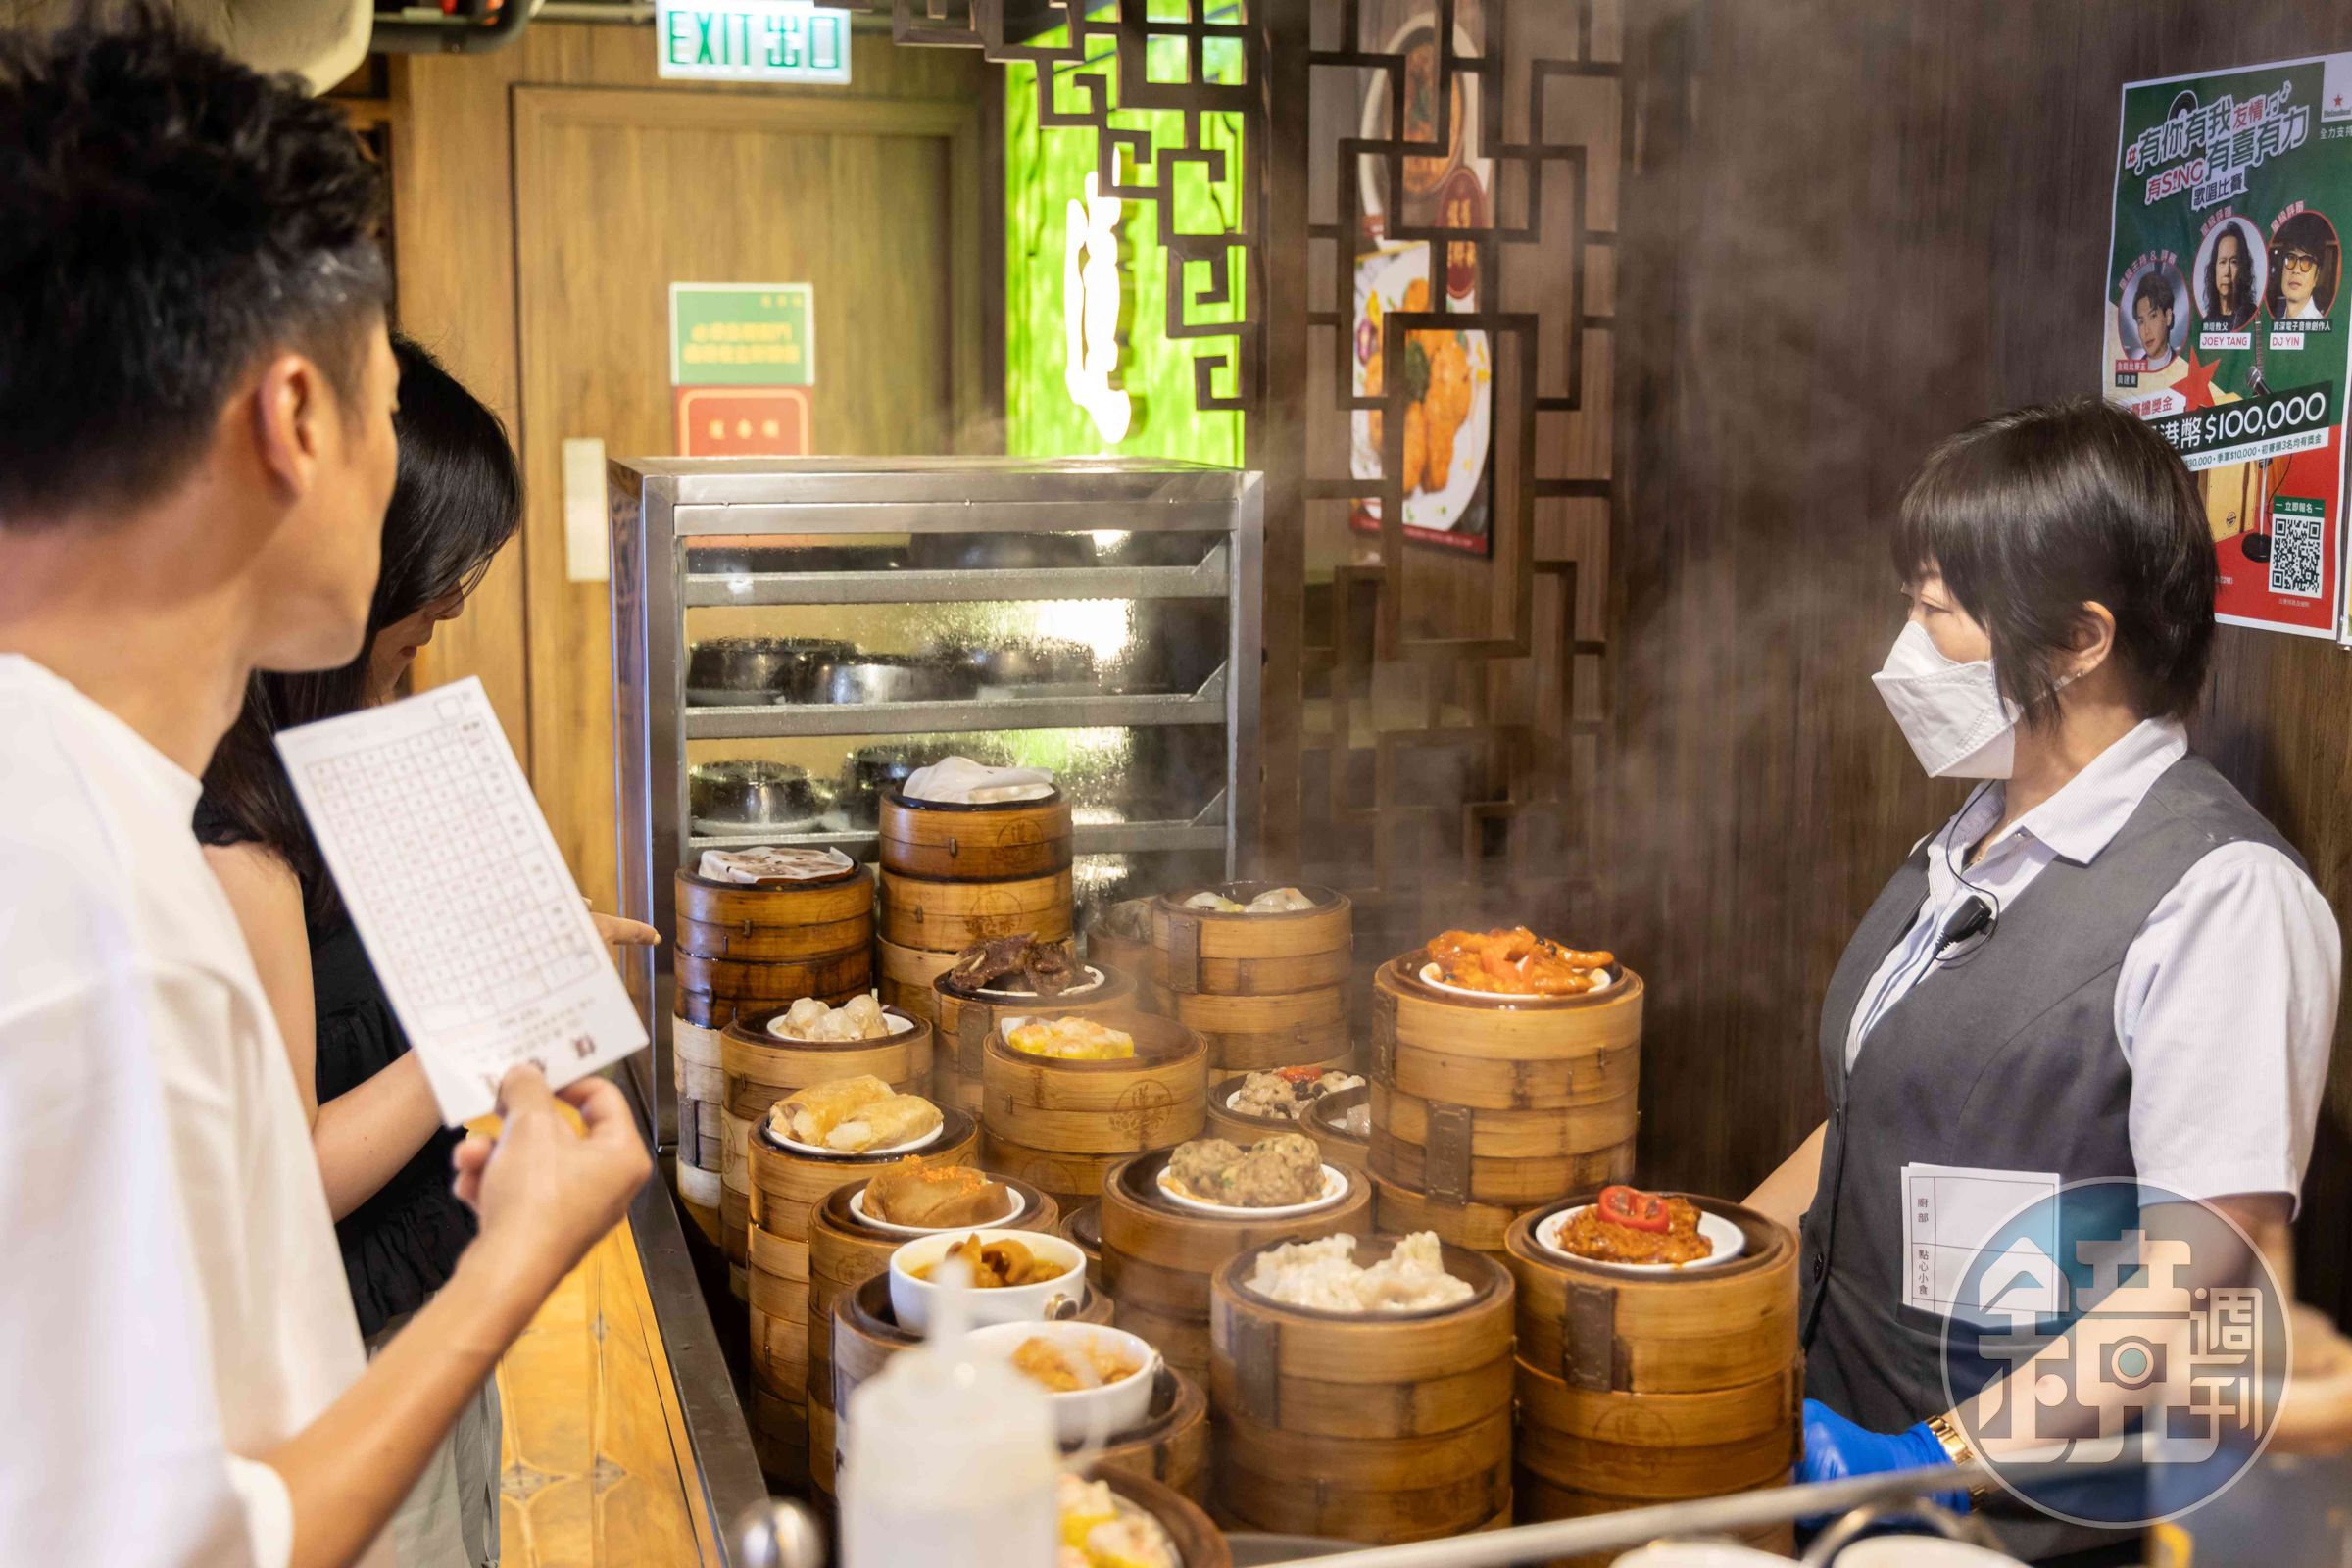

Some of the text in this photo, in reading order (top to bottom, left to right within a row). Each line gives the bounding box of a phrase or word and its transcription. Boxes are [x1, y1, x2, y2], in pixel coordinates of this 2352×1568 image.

[668, 10, 841, 70] EXIT 出口
[2193, 172, 2243, 206] 歌唱比賽
[2201, 336, 2248, 346] JOEY TANG
[2272, 336, 2300, 346] DJ YIN
[2129, 395, 2173, 416] 賽總獎金
[2152, 391, 2327, 450] 港幣 $100,000
[2284, 502, 2313, 513] 立即報名
[1917, 1197, 1929, 1223] 廚部
[1918, 1249, 1930, 1295] 點心小食
